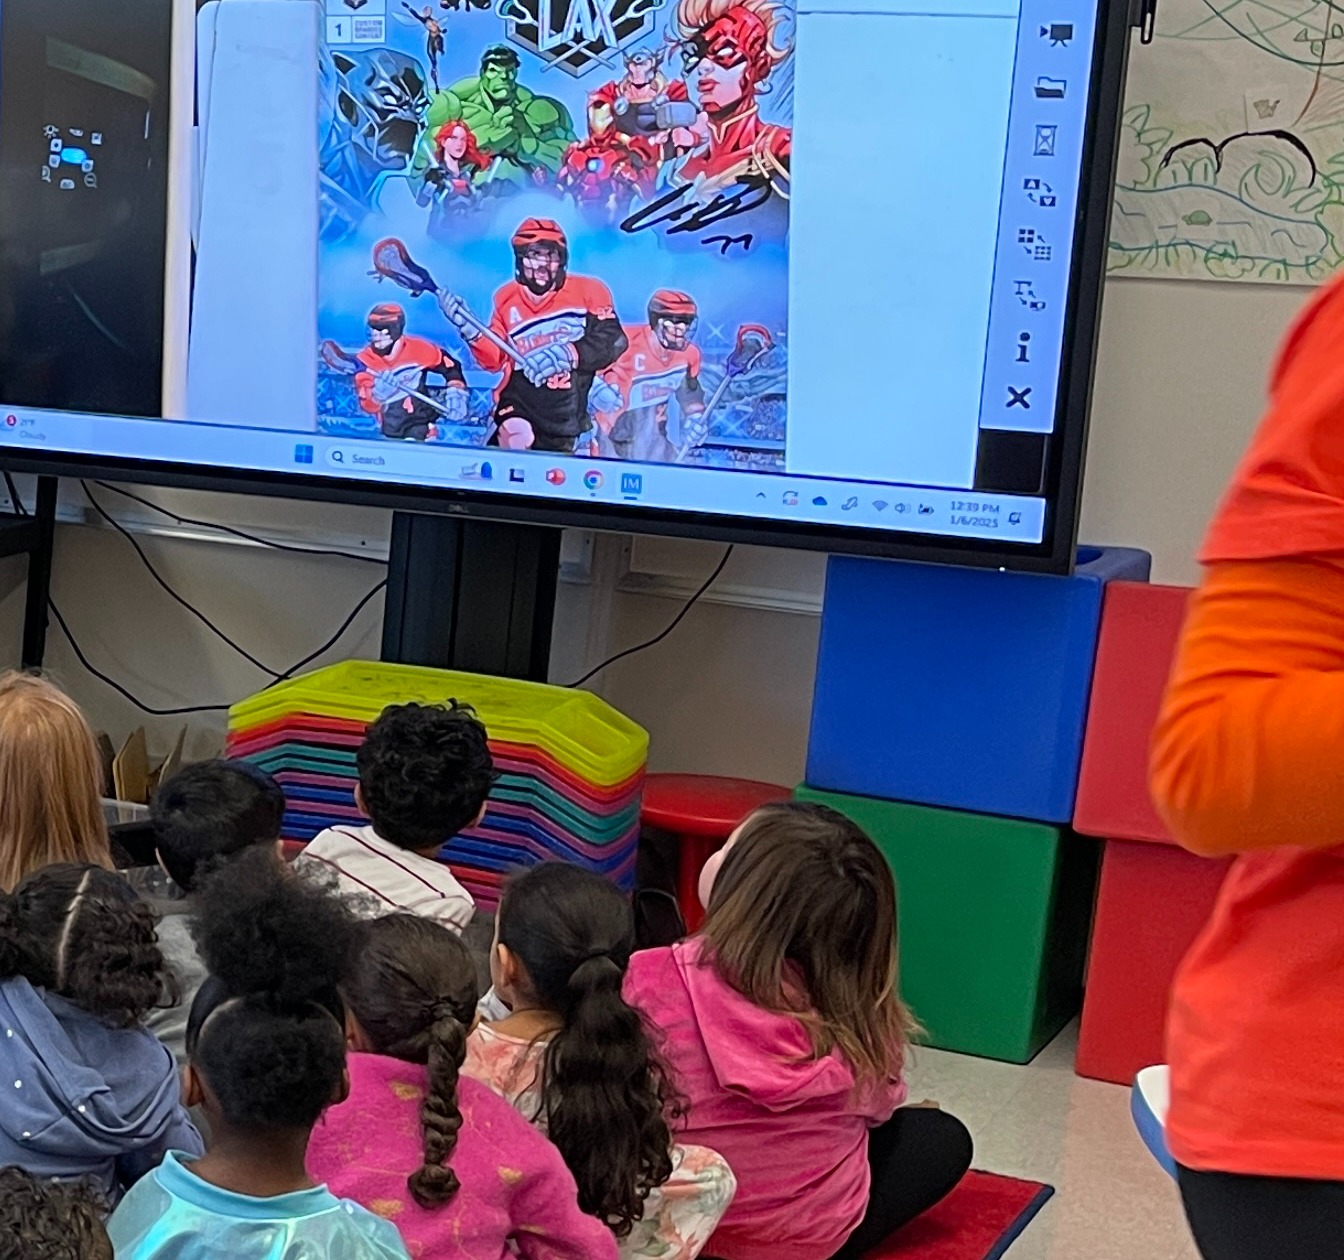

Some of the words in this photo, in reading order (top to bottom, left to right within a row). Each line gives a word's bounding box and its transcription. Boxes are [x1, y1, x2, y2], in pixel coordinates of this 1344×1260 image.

[334, 23, 342, 37] 1
[538, 0, 619, 51] LAX
[510, 307, 522, 324] A
[635, 354, 645, 371] C
[352, 453, 385, 467] Search
[624, 477, 639, 489] IM
[950, 501, 979, 512] 12:39
[982, 503, 1000, 514] PM
[950, 515, 999, 528] 1/6/2025
